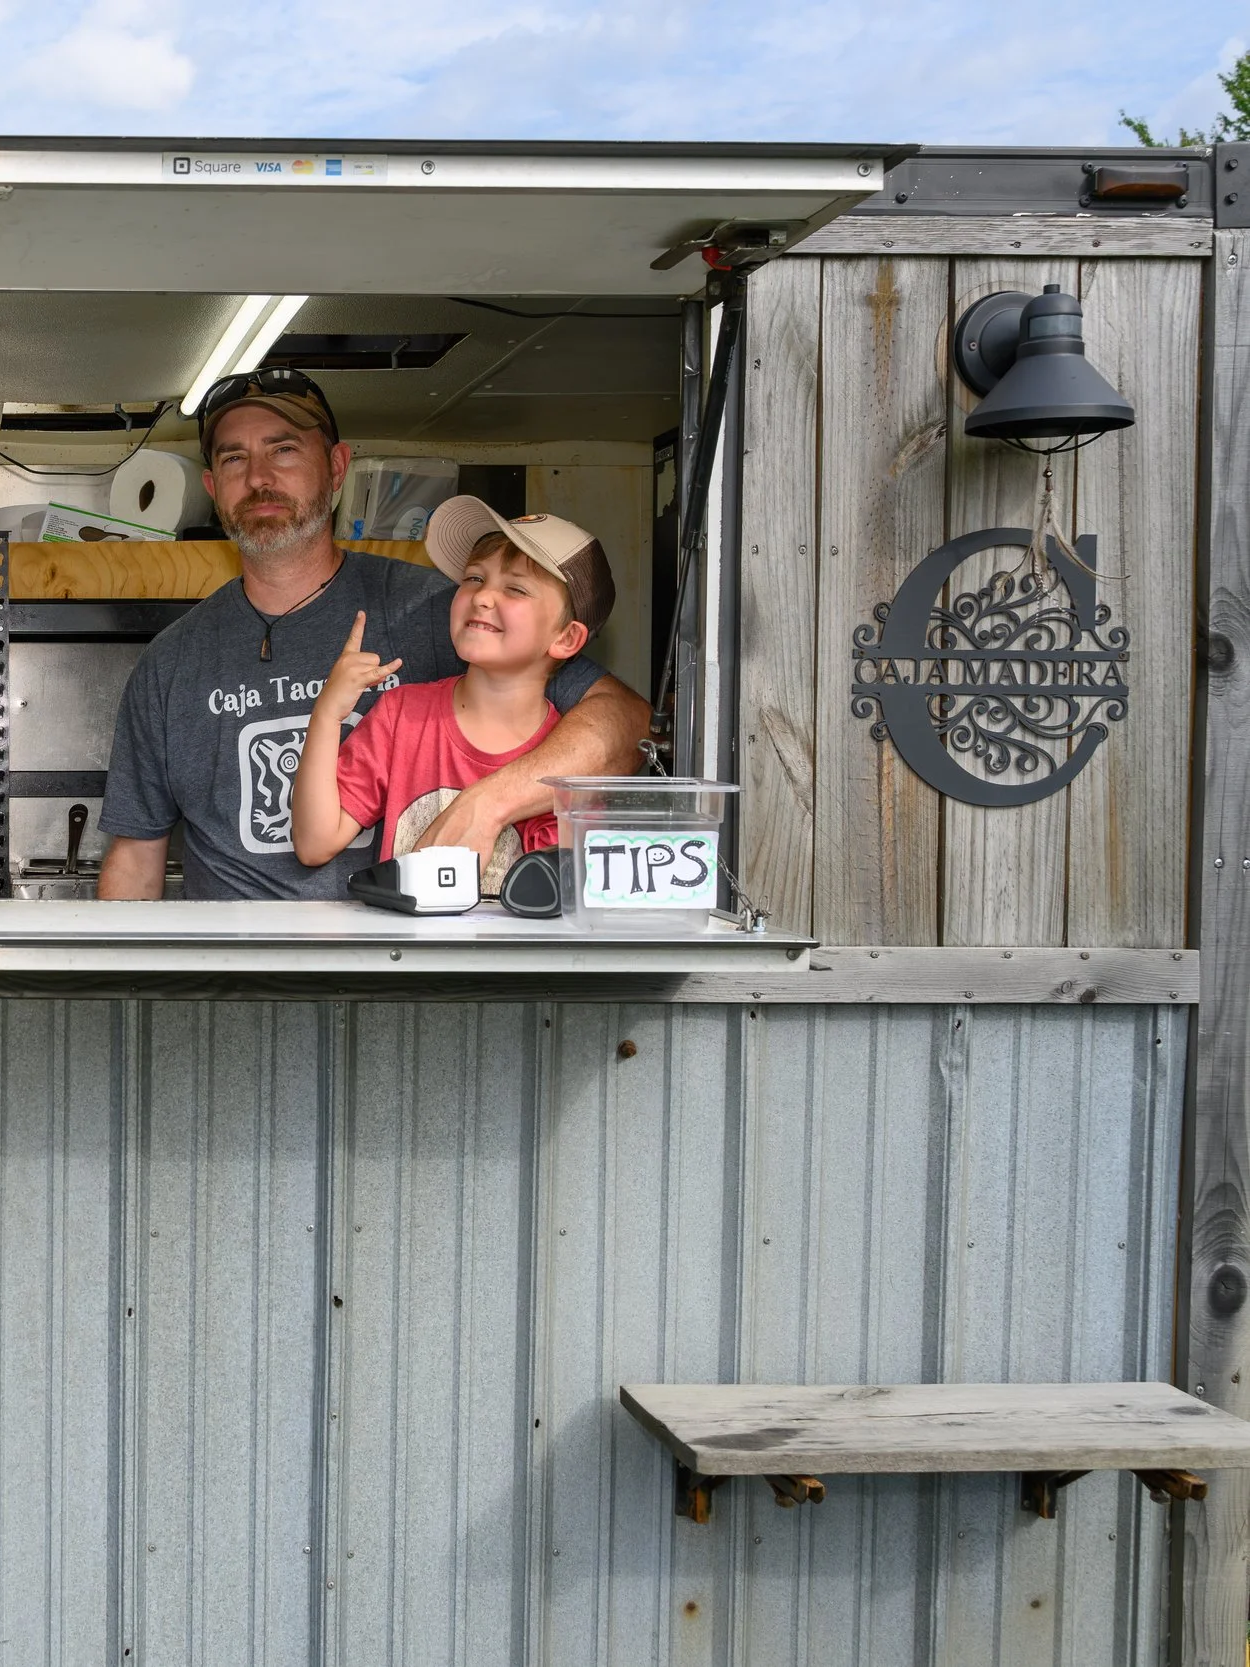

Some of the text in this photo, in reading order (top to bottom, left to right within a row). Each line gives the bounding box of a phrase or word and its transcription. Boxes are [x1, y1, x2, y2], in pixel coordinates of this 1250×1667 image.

[194, 160, 282, 174] Square VISA
[854, 657, 1125, 688] CAJA MADERA
[208, 684, 262, 718] Caja
[588, 840, 709, 894] TIPS
